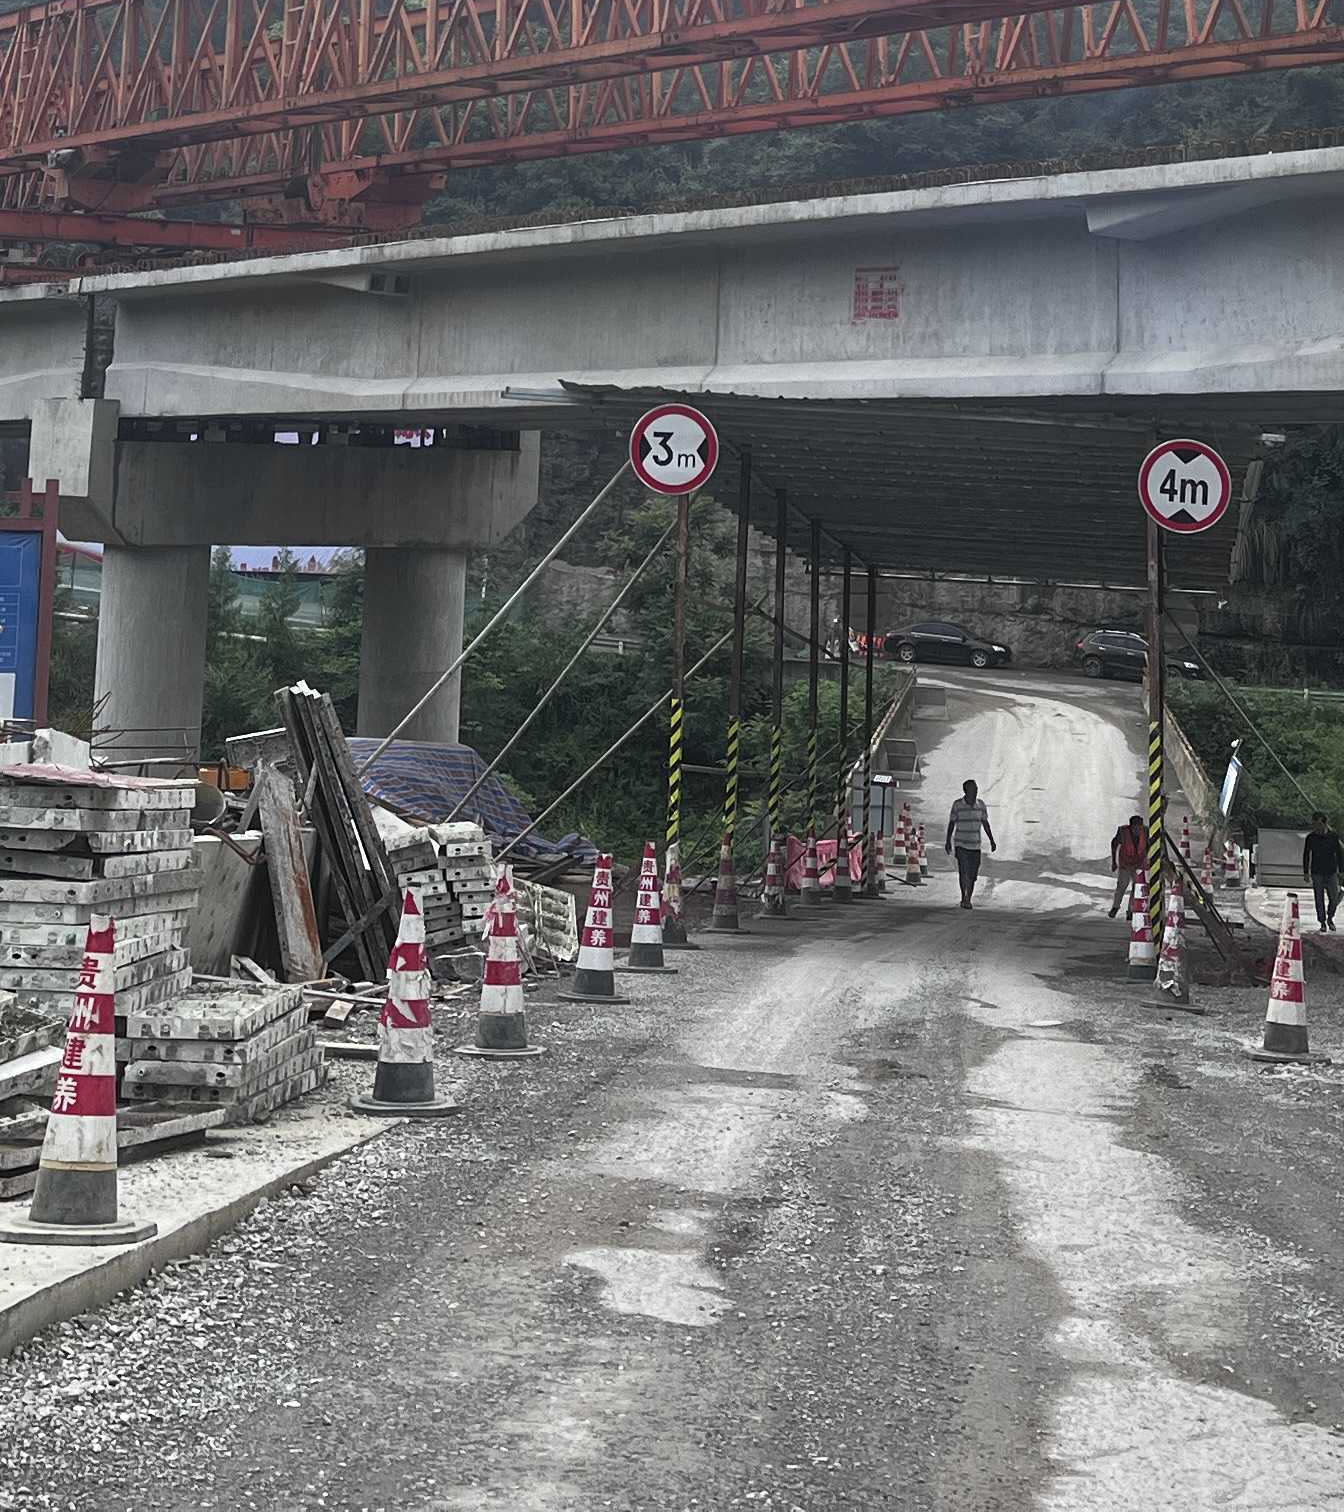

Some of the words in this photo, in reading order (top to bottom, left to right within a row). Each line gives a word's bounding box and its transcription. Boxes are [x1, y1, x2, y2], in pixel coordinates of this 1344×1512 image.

[651, 431, 697, 469] 3m
[1159, 469, 1209, 506] 4m
[590, 871, 609, 946] 贵州建养
[52, 956, 100, 1113] 贵州建养
